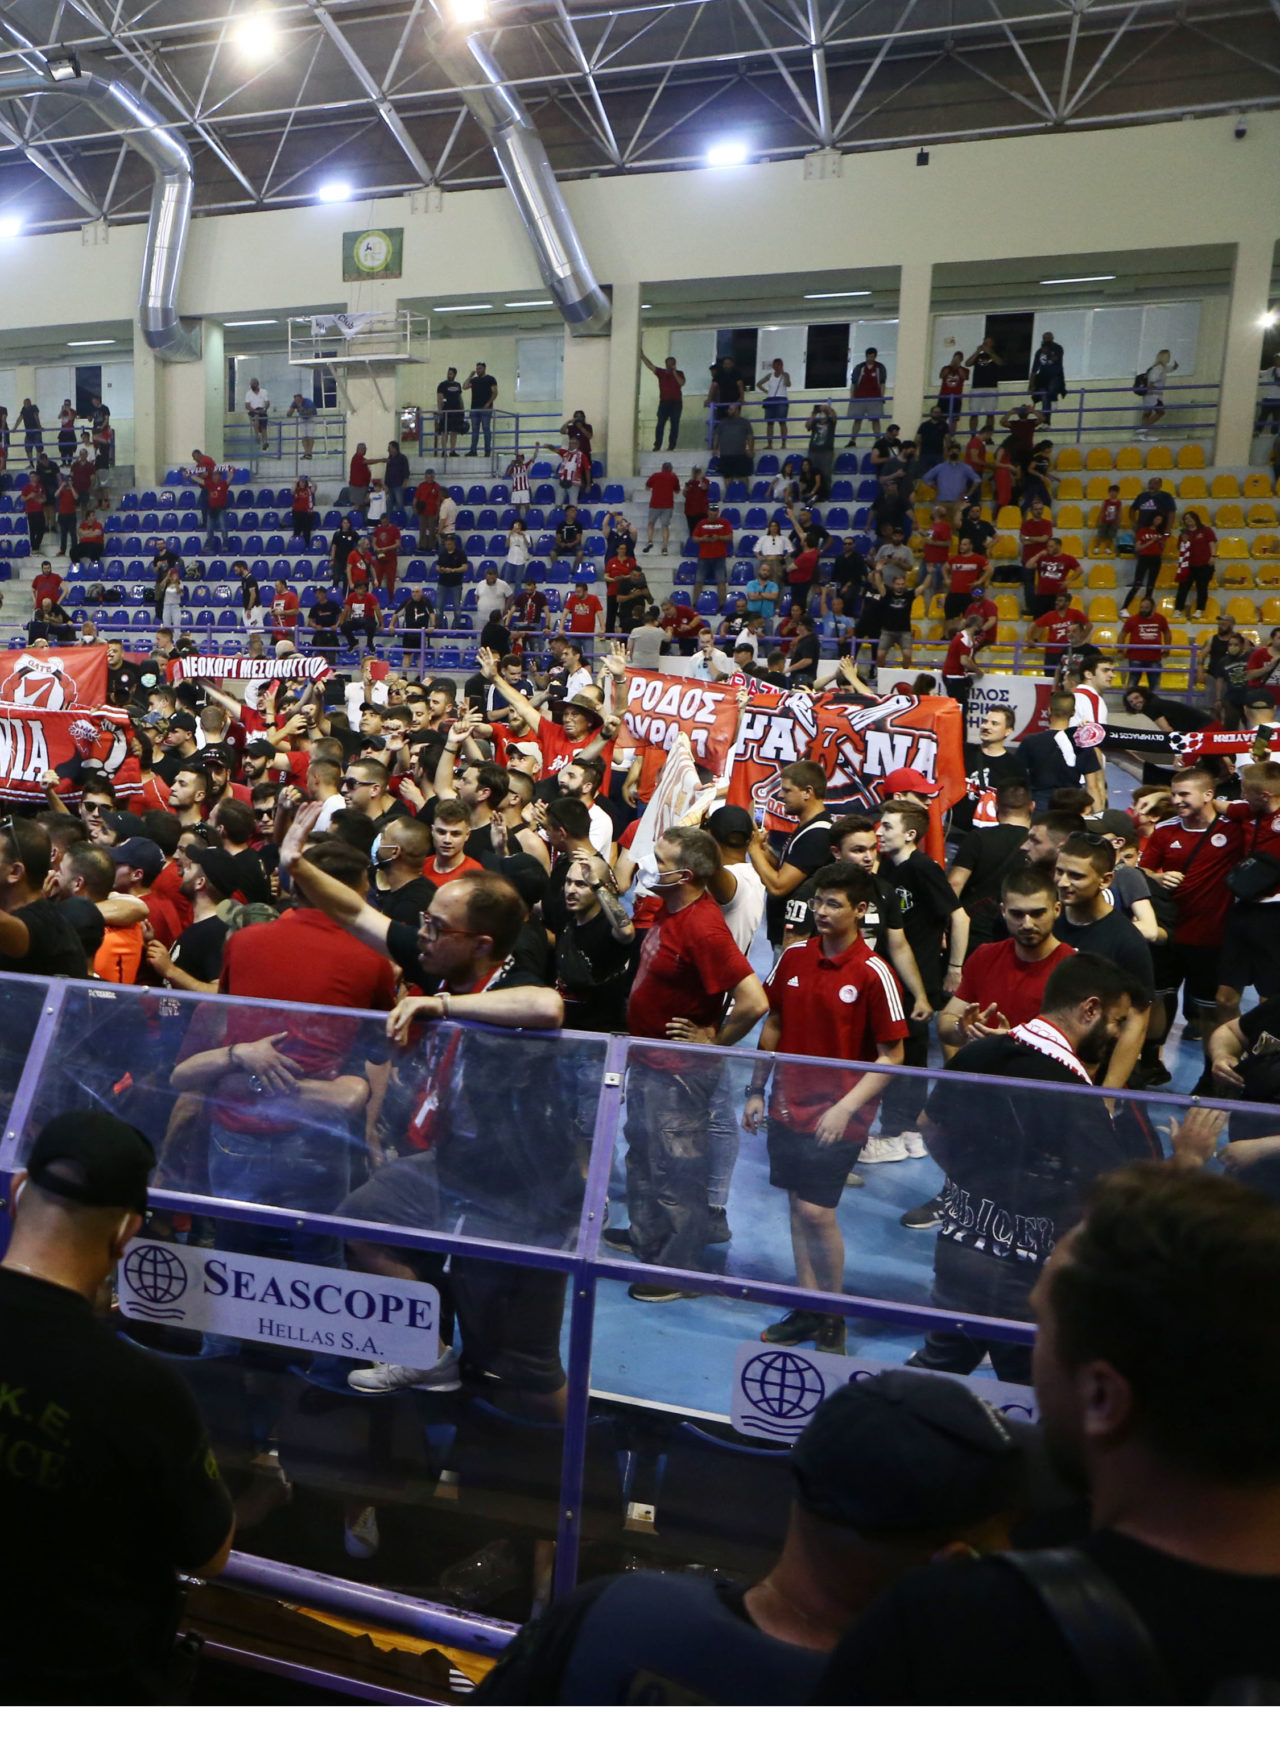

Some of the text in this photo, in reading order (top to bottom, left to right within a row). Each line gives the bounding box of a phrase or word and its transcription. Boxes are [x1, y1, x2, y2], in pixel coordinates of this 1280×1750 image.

[28, 659, 52, 673] GATE
[628, 677, 725, 724] ΡΟΔΟΣ
[203, 1259, 433, 1331] SEASCOPE
[258, 1318, 385, 1356] HELLAS S.A.
